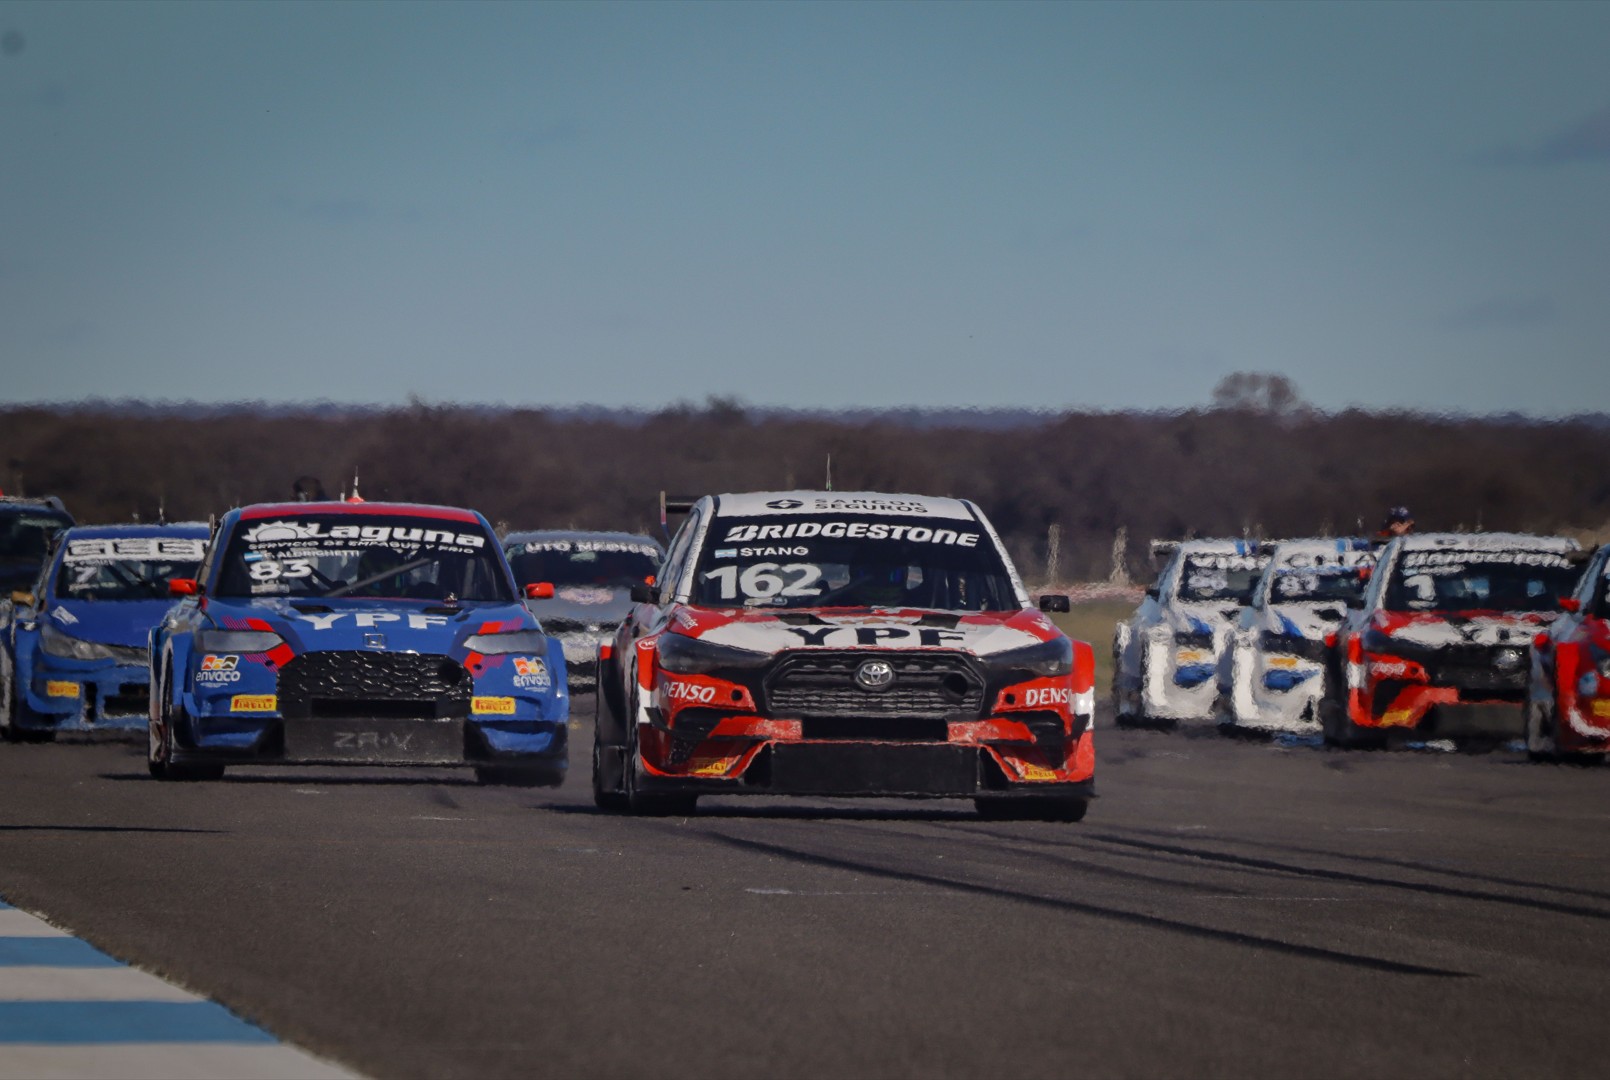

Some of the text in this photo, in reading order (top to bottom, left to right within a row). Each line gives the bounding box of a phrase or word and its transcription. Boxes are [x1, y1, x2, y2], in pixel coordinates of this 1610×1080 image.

[815, 498, 923, 507] SANCOR
[815, 503, 929, 513] SEGUROS
[304, 523, 485, 548] Laguna
[724, 522, 980, 547] BRIDGESTONE
[740, 546, 809, 557] STANG
[249, 559, 312, 580] 83
[705, 562, 822, 599] 162
[1404, 575, 1436, 600] 1
[297, 613, 448, 630] YPF
[785, 627, 966, 646] YPF
[662, 682, 716, 703] DENSO
